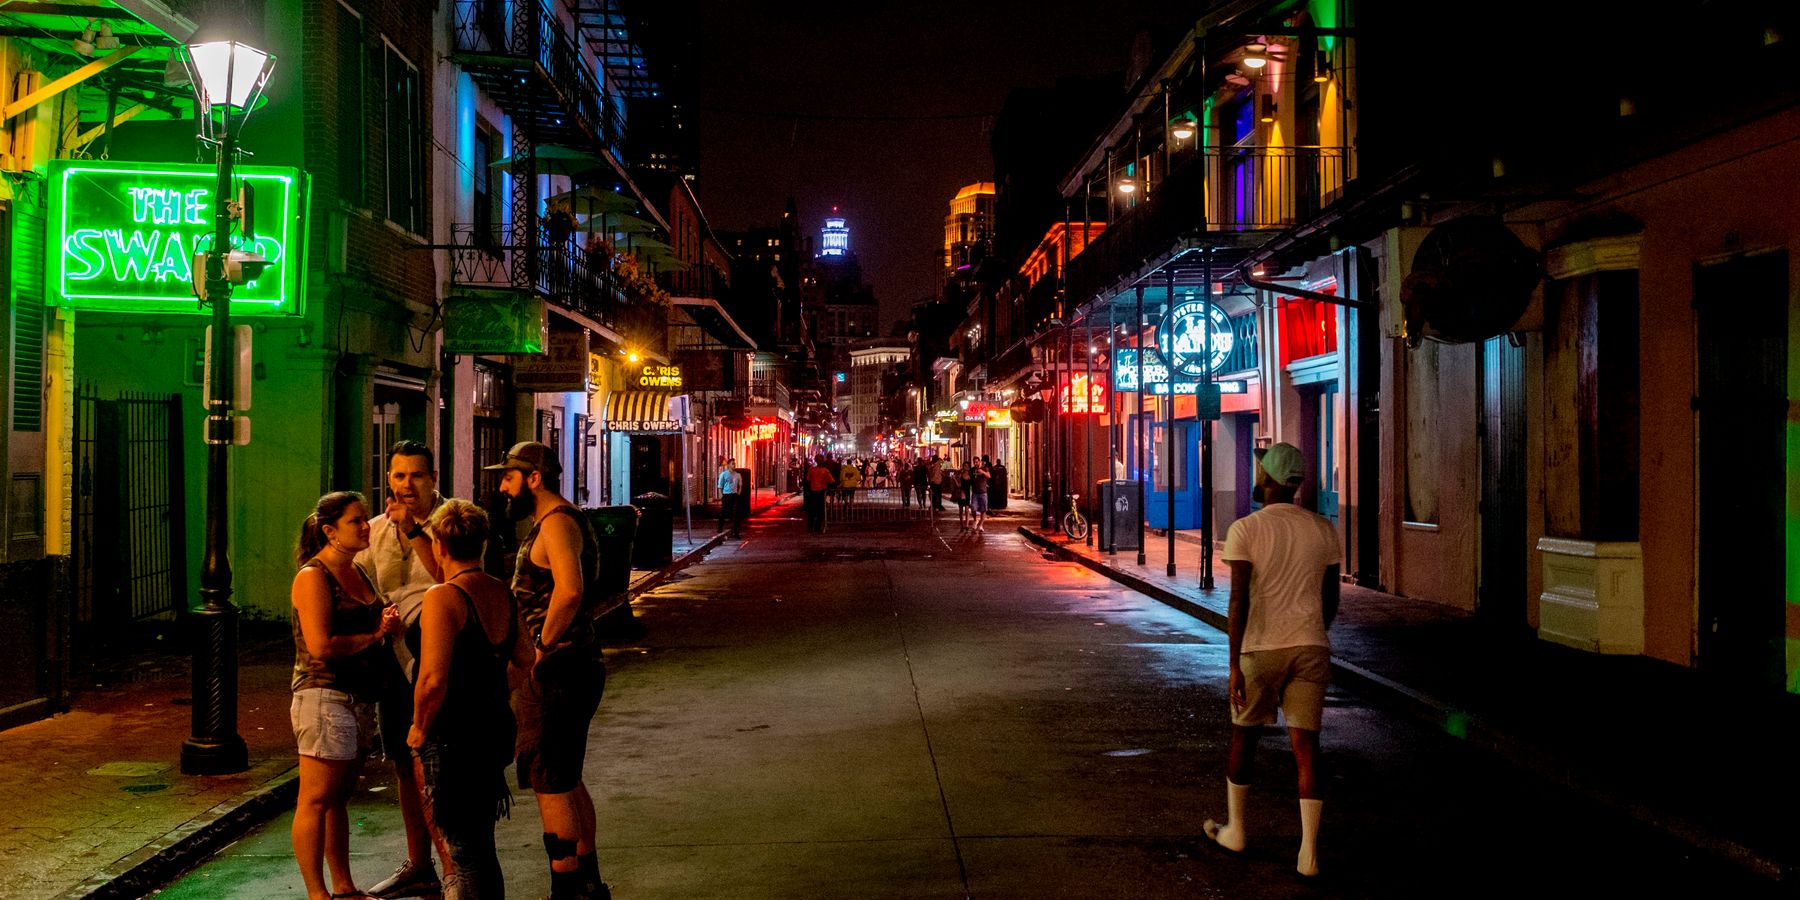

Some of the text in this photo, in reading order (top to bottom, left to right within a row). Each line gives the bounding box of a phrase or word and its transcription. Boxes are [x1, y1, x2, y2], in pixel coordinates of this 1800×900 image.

[128, 187, 208, 224] THE
[66, 229, 281, 288] SWAP
[643, 366, 680, 376] CRIS
[640, 376, 682, 387] OWENS
[1154, 382, 1197, 394] BACON
[608, 420, 679, 431] CHRIS OWENS
